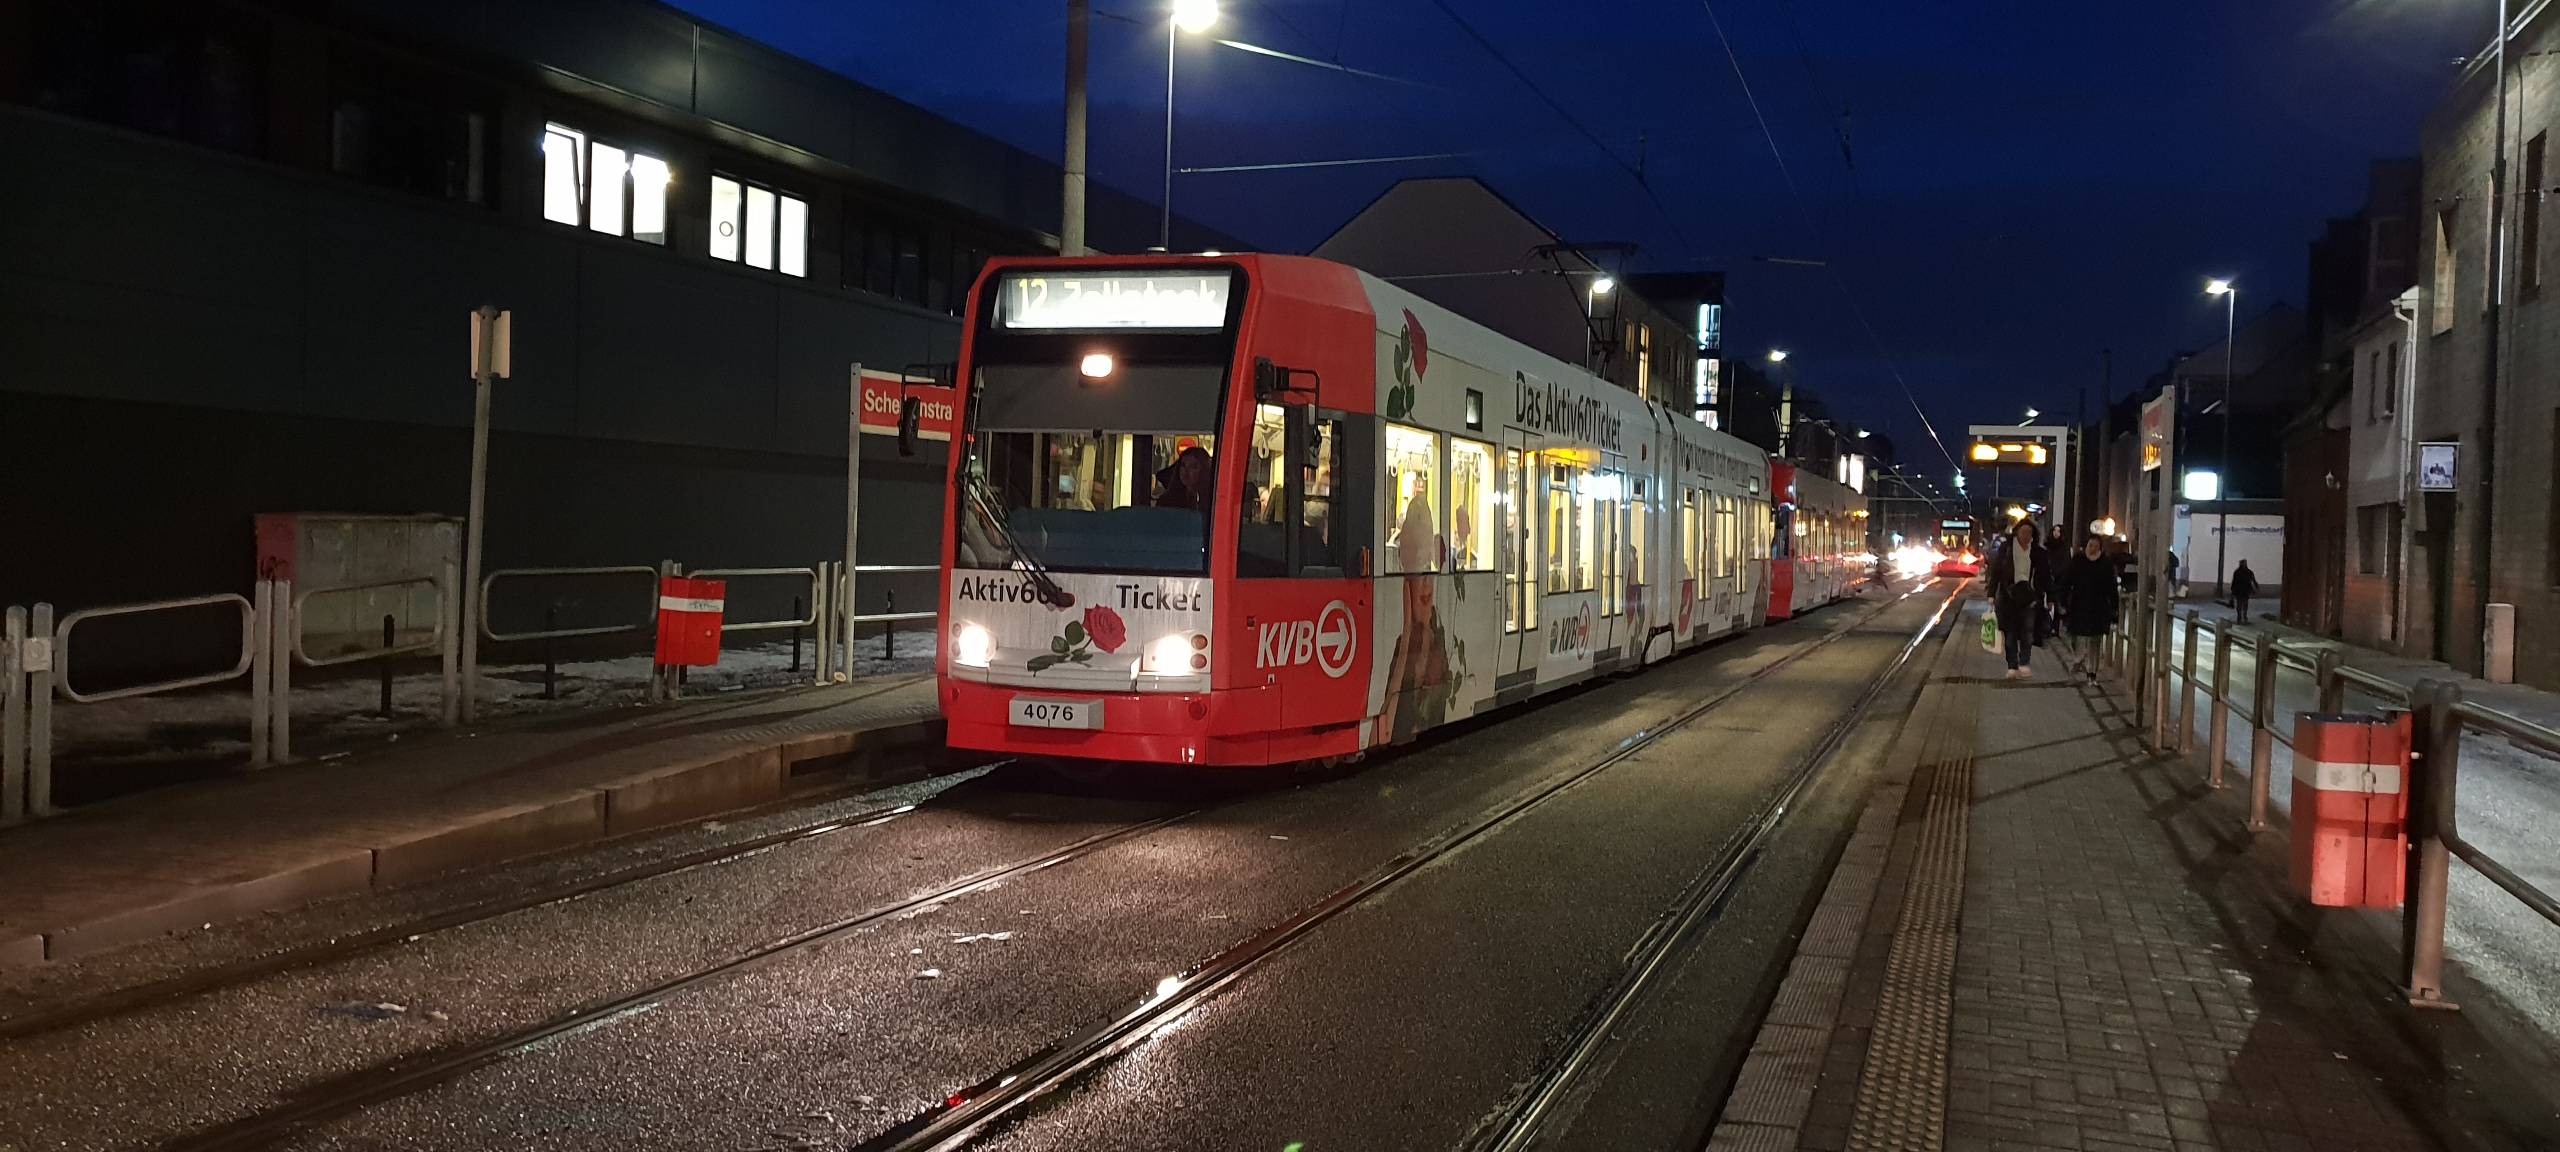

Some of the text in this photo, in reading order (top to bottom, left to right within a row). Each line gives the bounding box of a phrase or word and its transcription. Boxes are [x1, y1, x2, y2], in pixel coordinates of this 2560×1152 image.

[1019, 278, 1048, 321] 12
[1516, 370, 1621, 451] Das Aktiv60Ticket
[1116, 583, 1202, 611] Ticket
[1256, 620, 1315, 669] KVB
[1559, 616, 1578, 653] KVB
[1023, 704, 1074, 721] 4076
